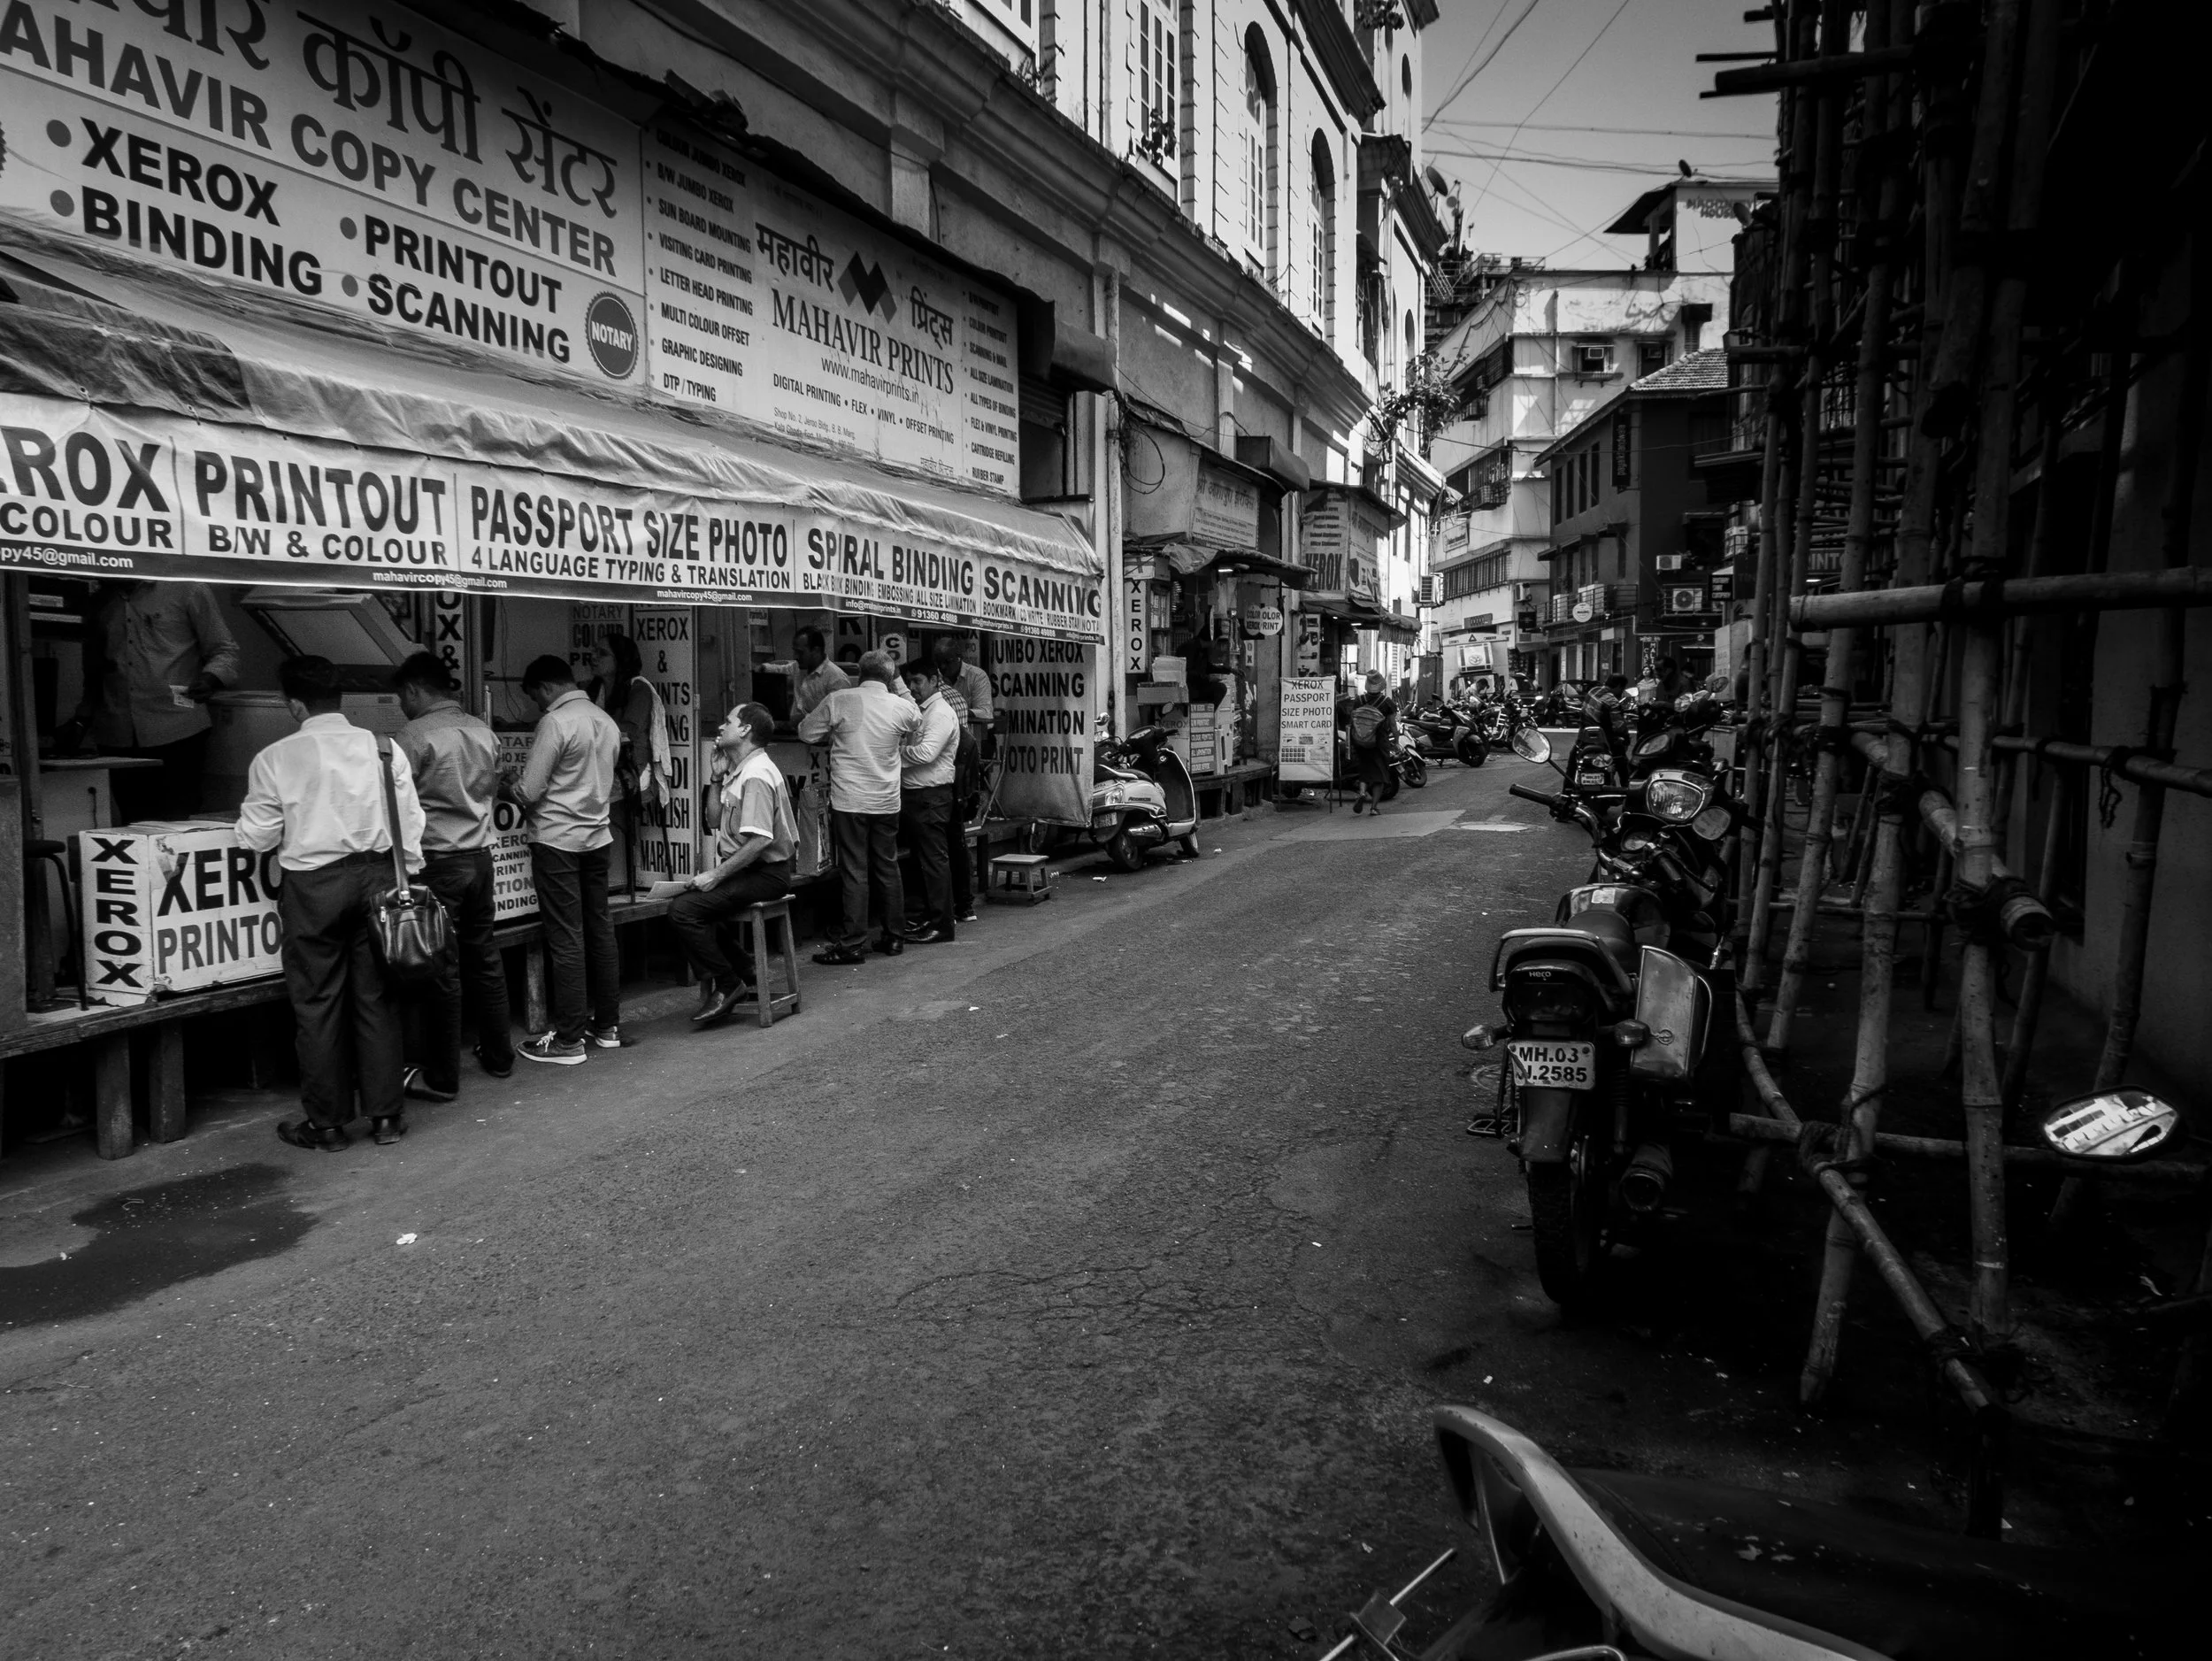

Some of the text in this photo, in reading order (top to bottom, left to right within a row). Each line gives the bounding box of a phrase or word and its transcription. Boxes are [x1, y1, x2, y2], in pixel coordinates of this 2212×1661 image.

[297, 10, 483, 165] कॉपी
[502, 86, 618, 219] सेंटर
[0, 0, 273, 150] AHAVIR
[291, 113, 435, 208] COPY
[453, 178, 617, 277] CENTER
[81, 116, 281, 227] XEROX
[677, 172, 706, 200] JUMBO
[708, 188, 734, 213] XEROX
[82, 186, 323, 296] BINDING
[658, 197, 751, 253] SUN BOARD MOUNTING
[365, 215, 562, 314] PRINTOUT
[659, 232, 752, 284] VISITING CARD PRINTING
[756, 222, 834, 292] महावीर
[660, 266, 753, 316] LETTER HEAD PRINTING
[367, 273, 570, 364] SCANNING
[592, 321, 634, 352] NOTARY
[661, 302, 749, 347] MULTI COLOUR OFFSET
[662, 338, 742, 377] GRAPHIC DESIGNING
[772, 288, 954, 394] MAHAVIR PRINTS
[664, 373, 680, 391] DTP
[687, 380, 716, 402] TYPING
[821, 358, 918, 403] www.mahavirprints.in
[773, 373, 955, 444] DIGITAL PRINTING FLEX VINYL OFFSET PRINTING
[979, 395, 991, 410] TYPES
[993, 400, 997, 411] OF
[998, 402, 1017, 419] BINDING
[971, 417, 980, 431] FLEX
[985, 421, 997, 436] VINYL
[998, 426, 1017, 442] PRINTING
[0, 425, 171, 513] ROX
[972, 442, 1015, 465] CARTRIDGE REFILLING
[194, 450, 446, 535] PRINTOUT
[972, 467, 1004, 485] RUBBER STAMP
[0, 502, 173, 550] COLOUR
[209, 525, 448, 566] B/W & COLOUR
[472, 485, 787, 568] PASSPORT SIZE PHOTO
[0, 544, 134, 569] py45@gmail.com
[472, 546, 790, 589] 4 LANGUAGE TYPING & TRANSLATION
[808, 528, 973, 596] SPIRAL BINDING
[373, 570, 508, 590] mahavircopy45@gmail.com
[657, 589, 753, 603] mahavircopy45@gmail.com
[984, 566, 1101, 619] SCANNING
[573, 605, 623, 619] NOTARY
[918, 609, 940, 620] 91360
[930, 592, 943, 608] SIZE
[983, 602, 1016, 619] BOOKMARK
[1263, 611, 1280, 620] OLOR
[636, 617, 688, 641] XEROX
[1131, 580, 1142, 670] XEROX
[657, 650, 667, 673] &
[991, 639, 1084, 663] JUMBO XEROX
[991, 673, 1084, 697] SCANNING
[1284, 693, 1331, 703] PASSPORT
[1292, 681, 1324, 690] XEROX
[1009, 710, 1084, 734] MINATION
[1281, 720, 1308, 729] SMART
[1282, 707, 1332, 717] SIZE PHOTO
[1041, 746, 1083, 774] PRINT
[496, 863, 524, 875] RINT
[641, 839, 690, 874] MARATHI
[157, 848, 280, 917] XERO
[90, 837, 142, 988] XEROX
[158, 911, 282, 974] PRINTO
[1519, 1047, 1578, 1063] MH.03
